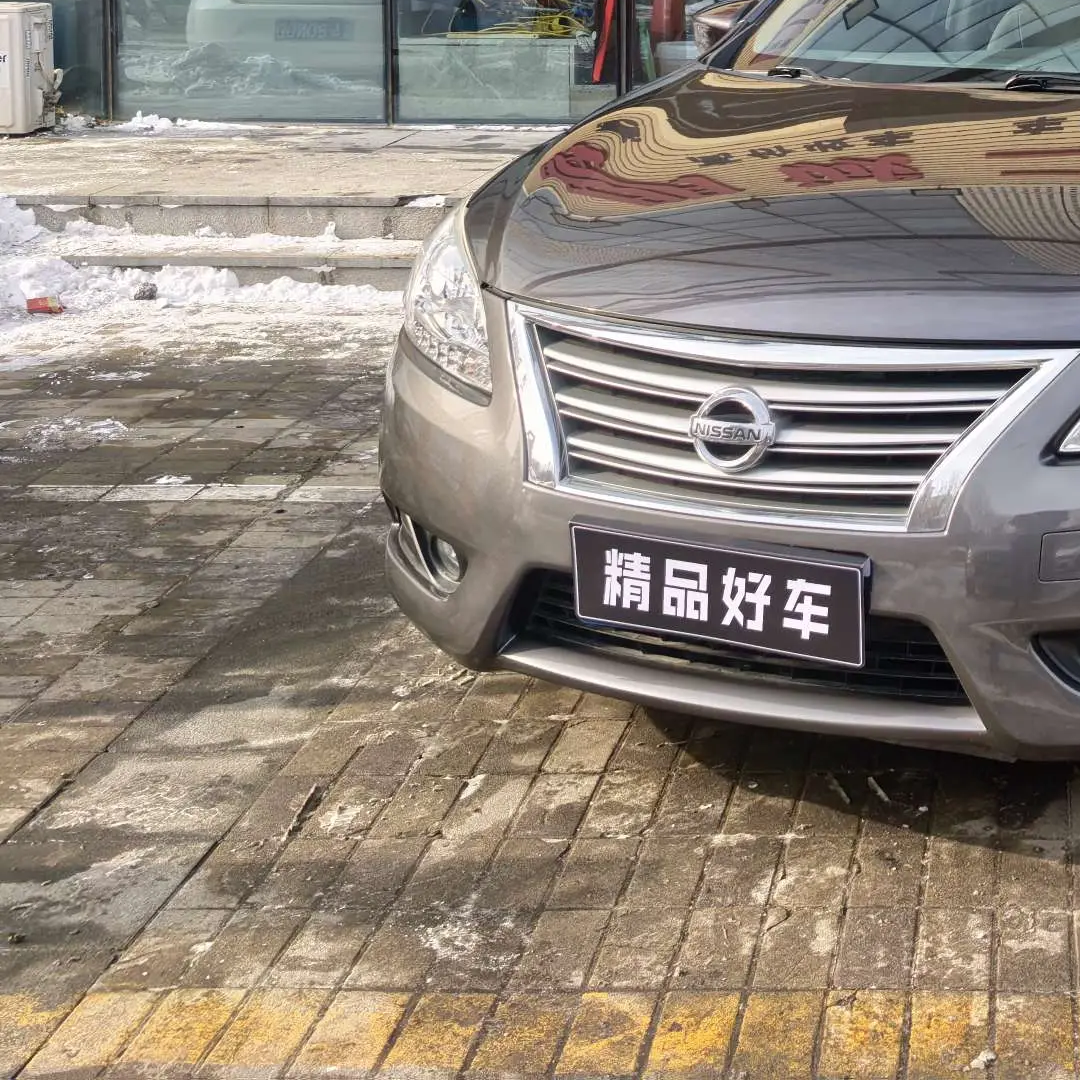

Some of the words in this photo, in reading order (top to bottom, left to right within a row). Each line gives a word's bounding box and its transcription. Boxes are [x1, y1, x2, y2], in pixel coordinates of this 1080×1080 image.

[694, 422, 761, 441] NISSAN
[603, 548, 832, 640] 精品好车
